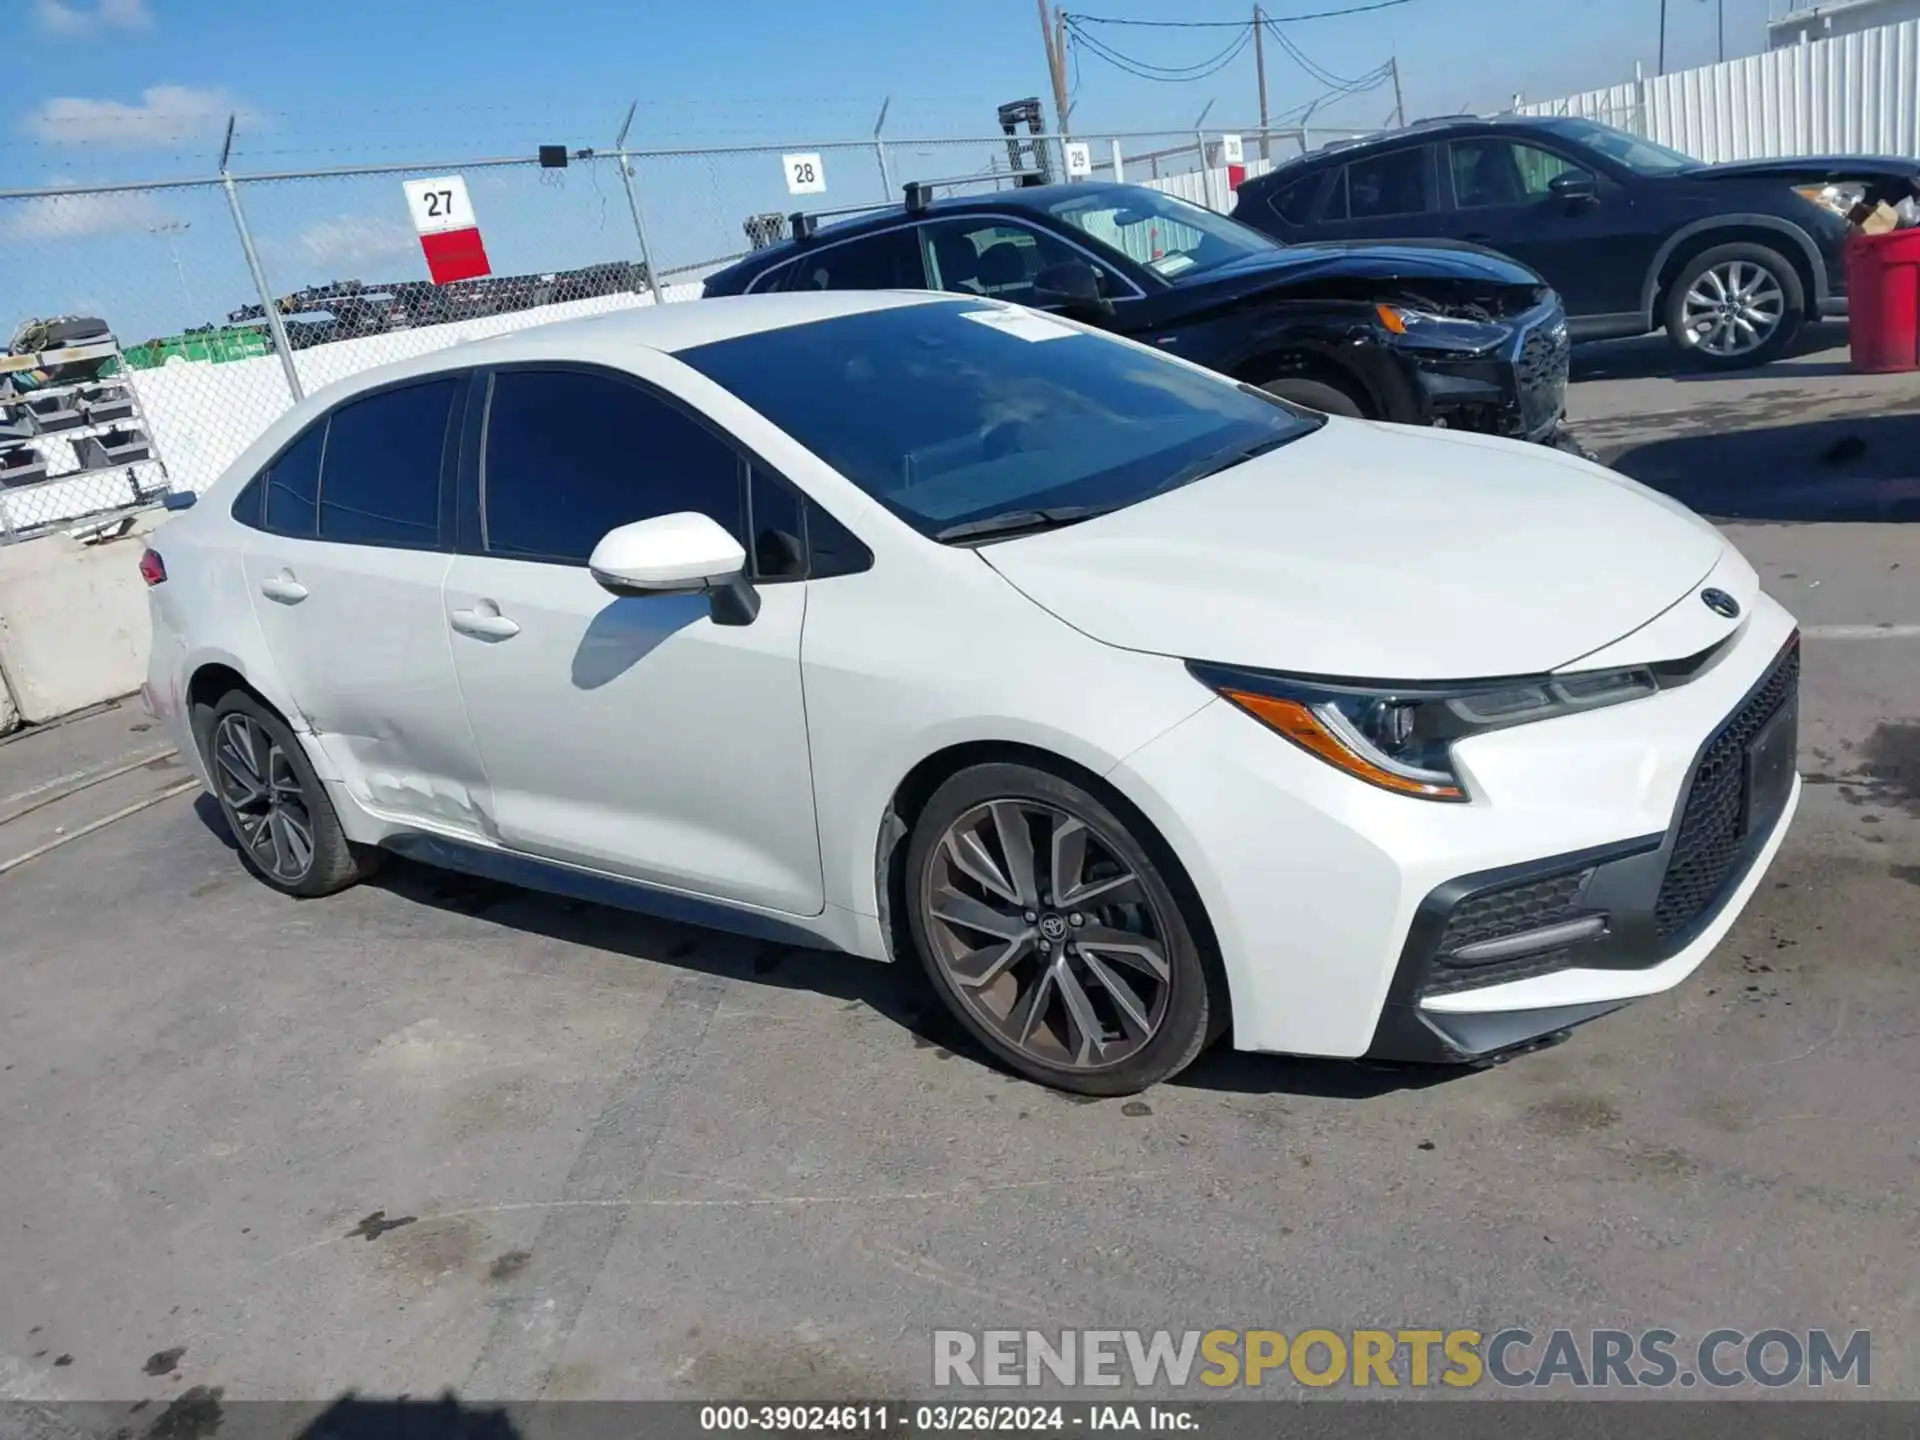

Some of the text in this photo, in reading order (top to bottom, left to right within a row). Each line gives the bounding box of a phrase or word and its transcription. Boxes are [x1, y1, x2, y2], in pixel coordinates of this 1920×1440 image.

[1071, 151, 1085, 168] 29
[794, 163, 815, 184] 28
[423, 190, 452, 217] 27
